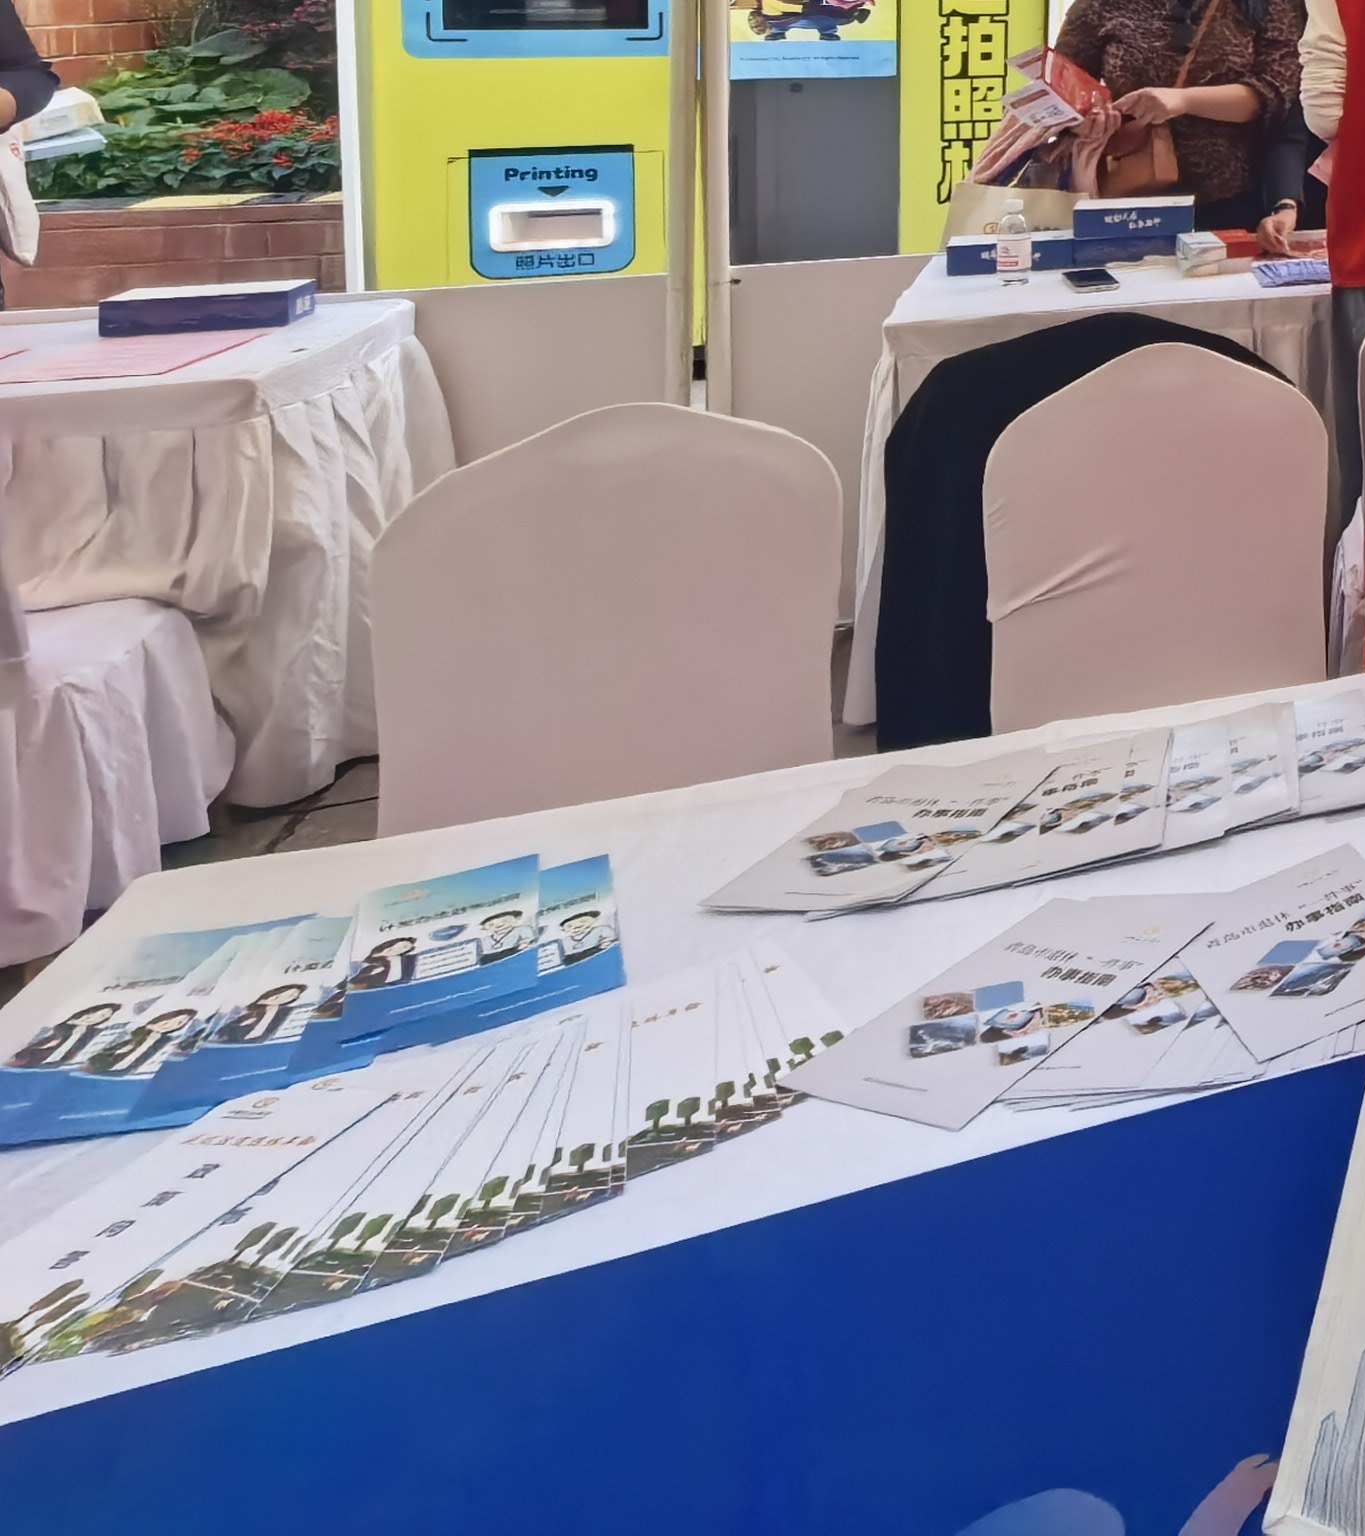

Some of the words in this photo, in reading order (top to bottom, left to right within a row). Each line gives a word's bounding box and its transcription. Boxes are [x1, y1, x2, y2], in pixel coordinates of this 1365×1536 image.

[504, 166, 598, 182] Printing
[516, 253, 595, 270] 照片出口
